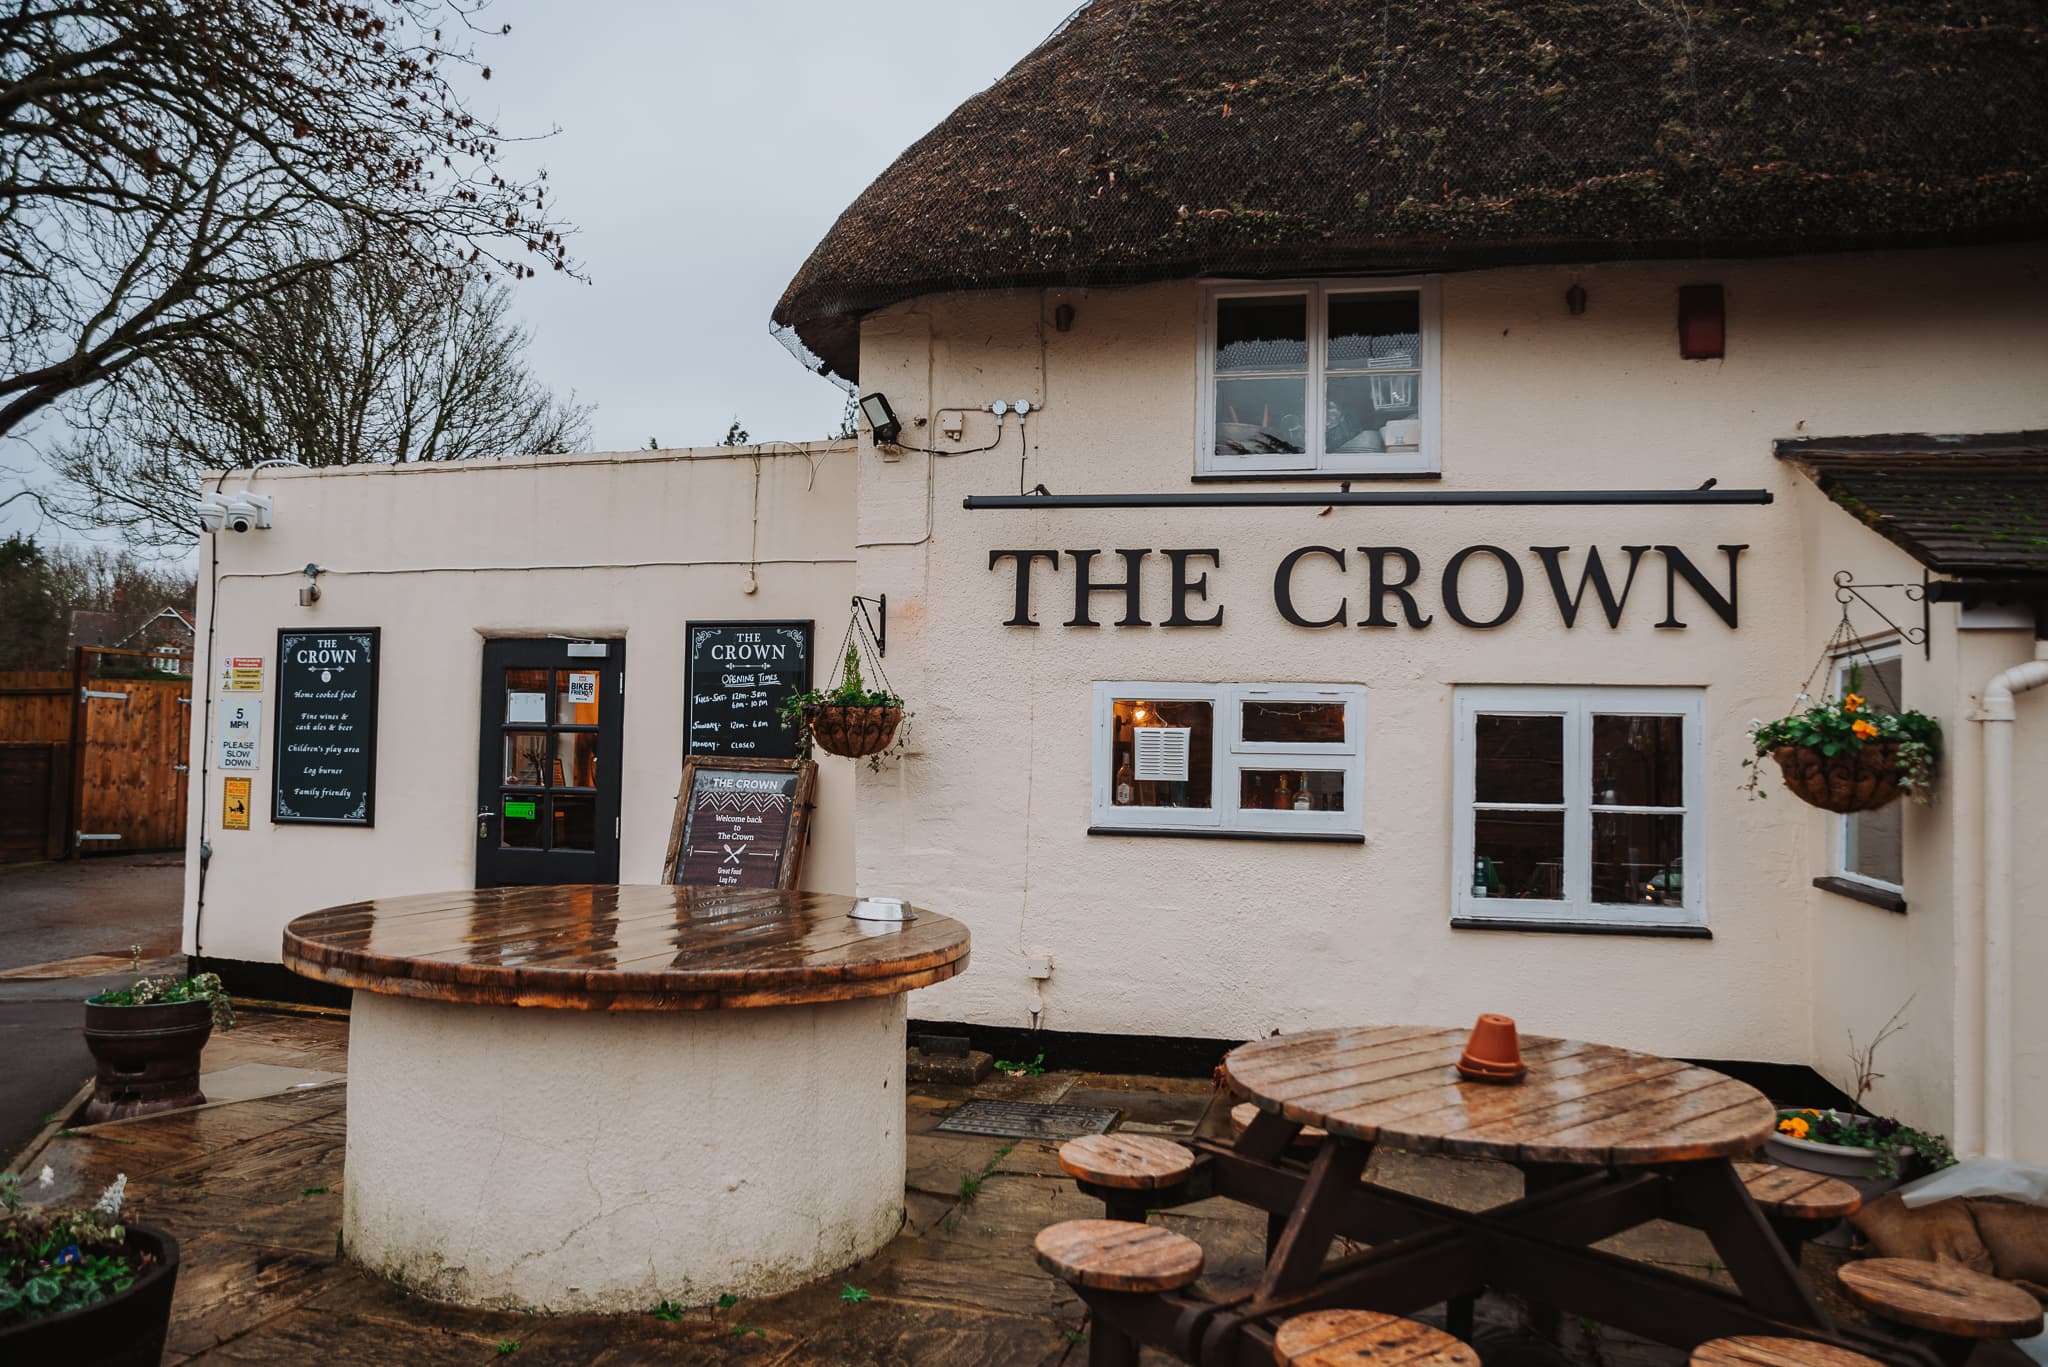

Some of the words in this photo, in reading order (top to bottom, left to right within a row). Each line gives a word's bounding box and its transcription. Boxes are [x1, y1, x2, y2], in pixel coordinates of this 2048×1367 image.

[988, 548, 1224, 629] THE
[1273, 544, 1750, 630] CROWN
[736, 633, 761, 643] THE
[317, 640, 337, 648] THE
[298, 650, 357, 663] CROWN
[711, 644, 786, 660] CROWN
[571, 682, 593, 690] BIKER
[316, 690, 340, 698] cooked
[339, 690, 357, 701] food
[236, 708, 244, 719] 5
[223, 741, 254, 750] PLEASE
[288, 744, 323, 752] Children's
[325, 745, 341, 755] play
[226, 750, 250, 758] SLOW
[225, 759, 251, 767] DOWN
[304, 767, 316, 776] Log
[318, 766, 343, 775] burner
[713, 778, 733, 788] THE
[736, 779, 778, 790] CROWN
[294, 788, 320, 798] Family
[321, 788, 351, 799] friendly
